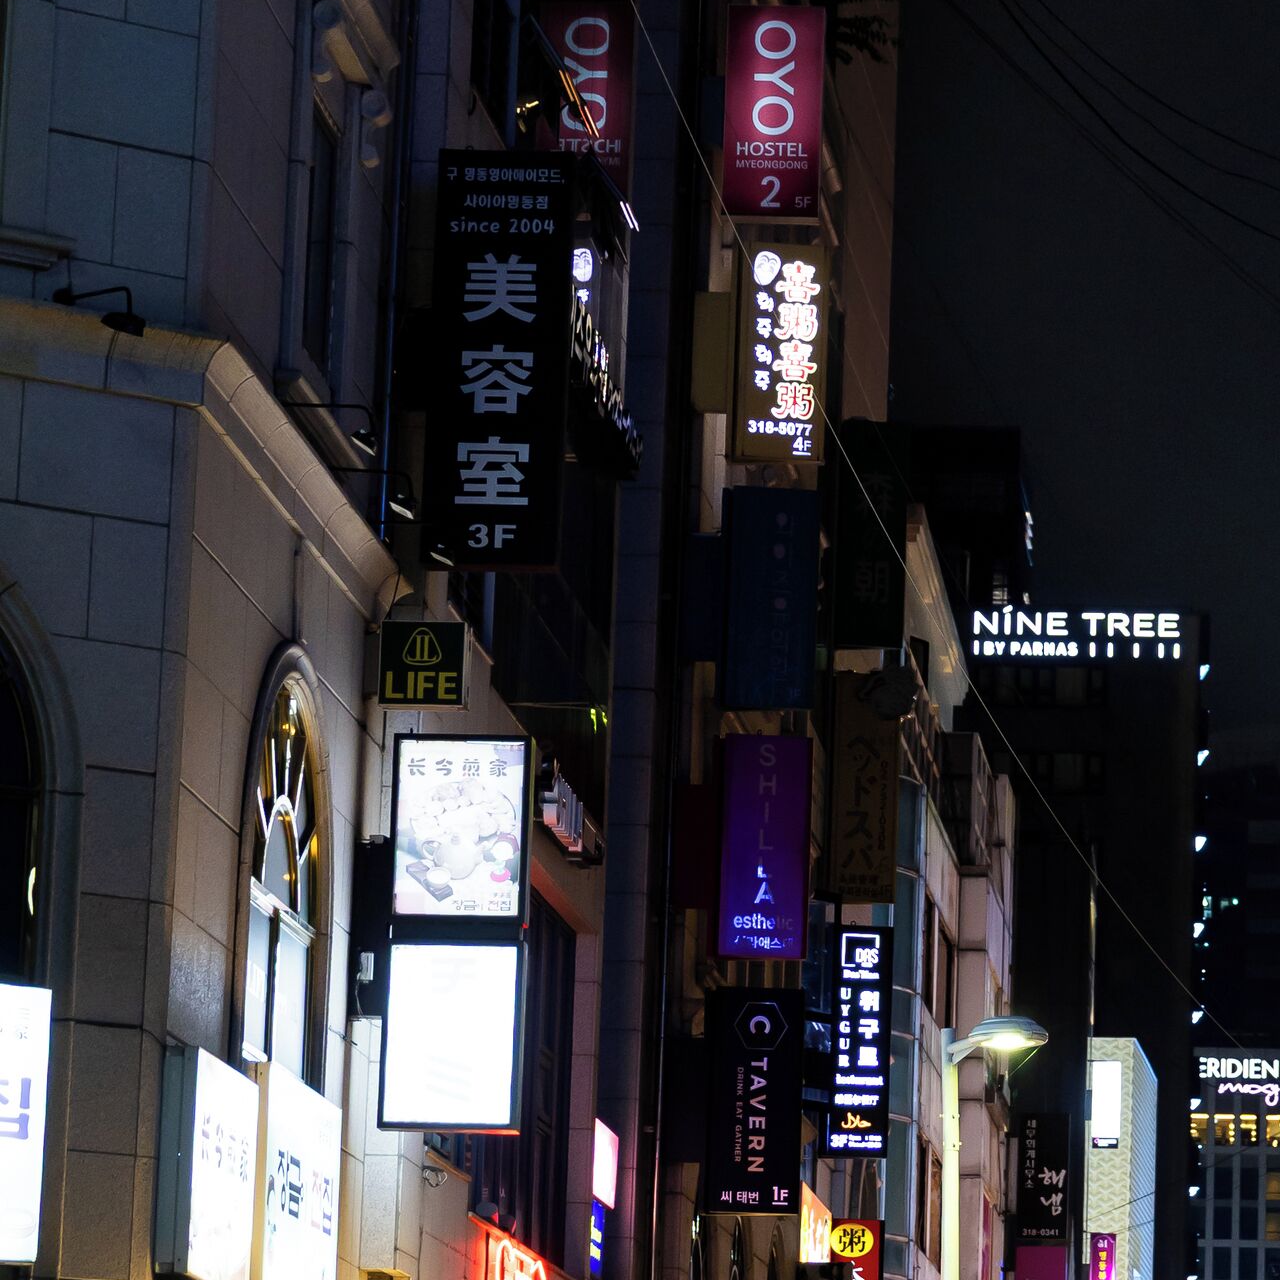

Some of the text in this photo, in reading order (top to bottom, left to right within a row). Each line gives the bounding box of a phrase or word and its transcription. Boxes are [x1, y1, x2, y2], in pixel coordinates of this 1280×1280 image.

[752, 20, 796, 135] OYO
[736, 141, 807, 157] HOSTEL
[735, 159, 808, 170] MYEONGDONG
[760, 176, 780, 208] 2
[450, 216, 555, 235] since 2004
[454, 253, 538, 507] 美容室
[748, 419, 813, 436] 318-5077
[467, 524, 516, 549] 3F
[1081, 612, 1181, 638] TREE
[384, 672, 458, 700] LIFE
[838, 988, 852, 1068] UYGUR
[733, 1066, 745, 1162] DRINK EAT GATHER
[748, 1057, 768, 1172] TAVERN
[773, 1185, 789, 1201] 1F
[839, 1228, 866, 1253] 粥
[1022, 1228, 1059, 1237] 318-0341
